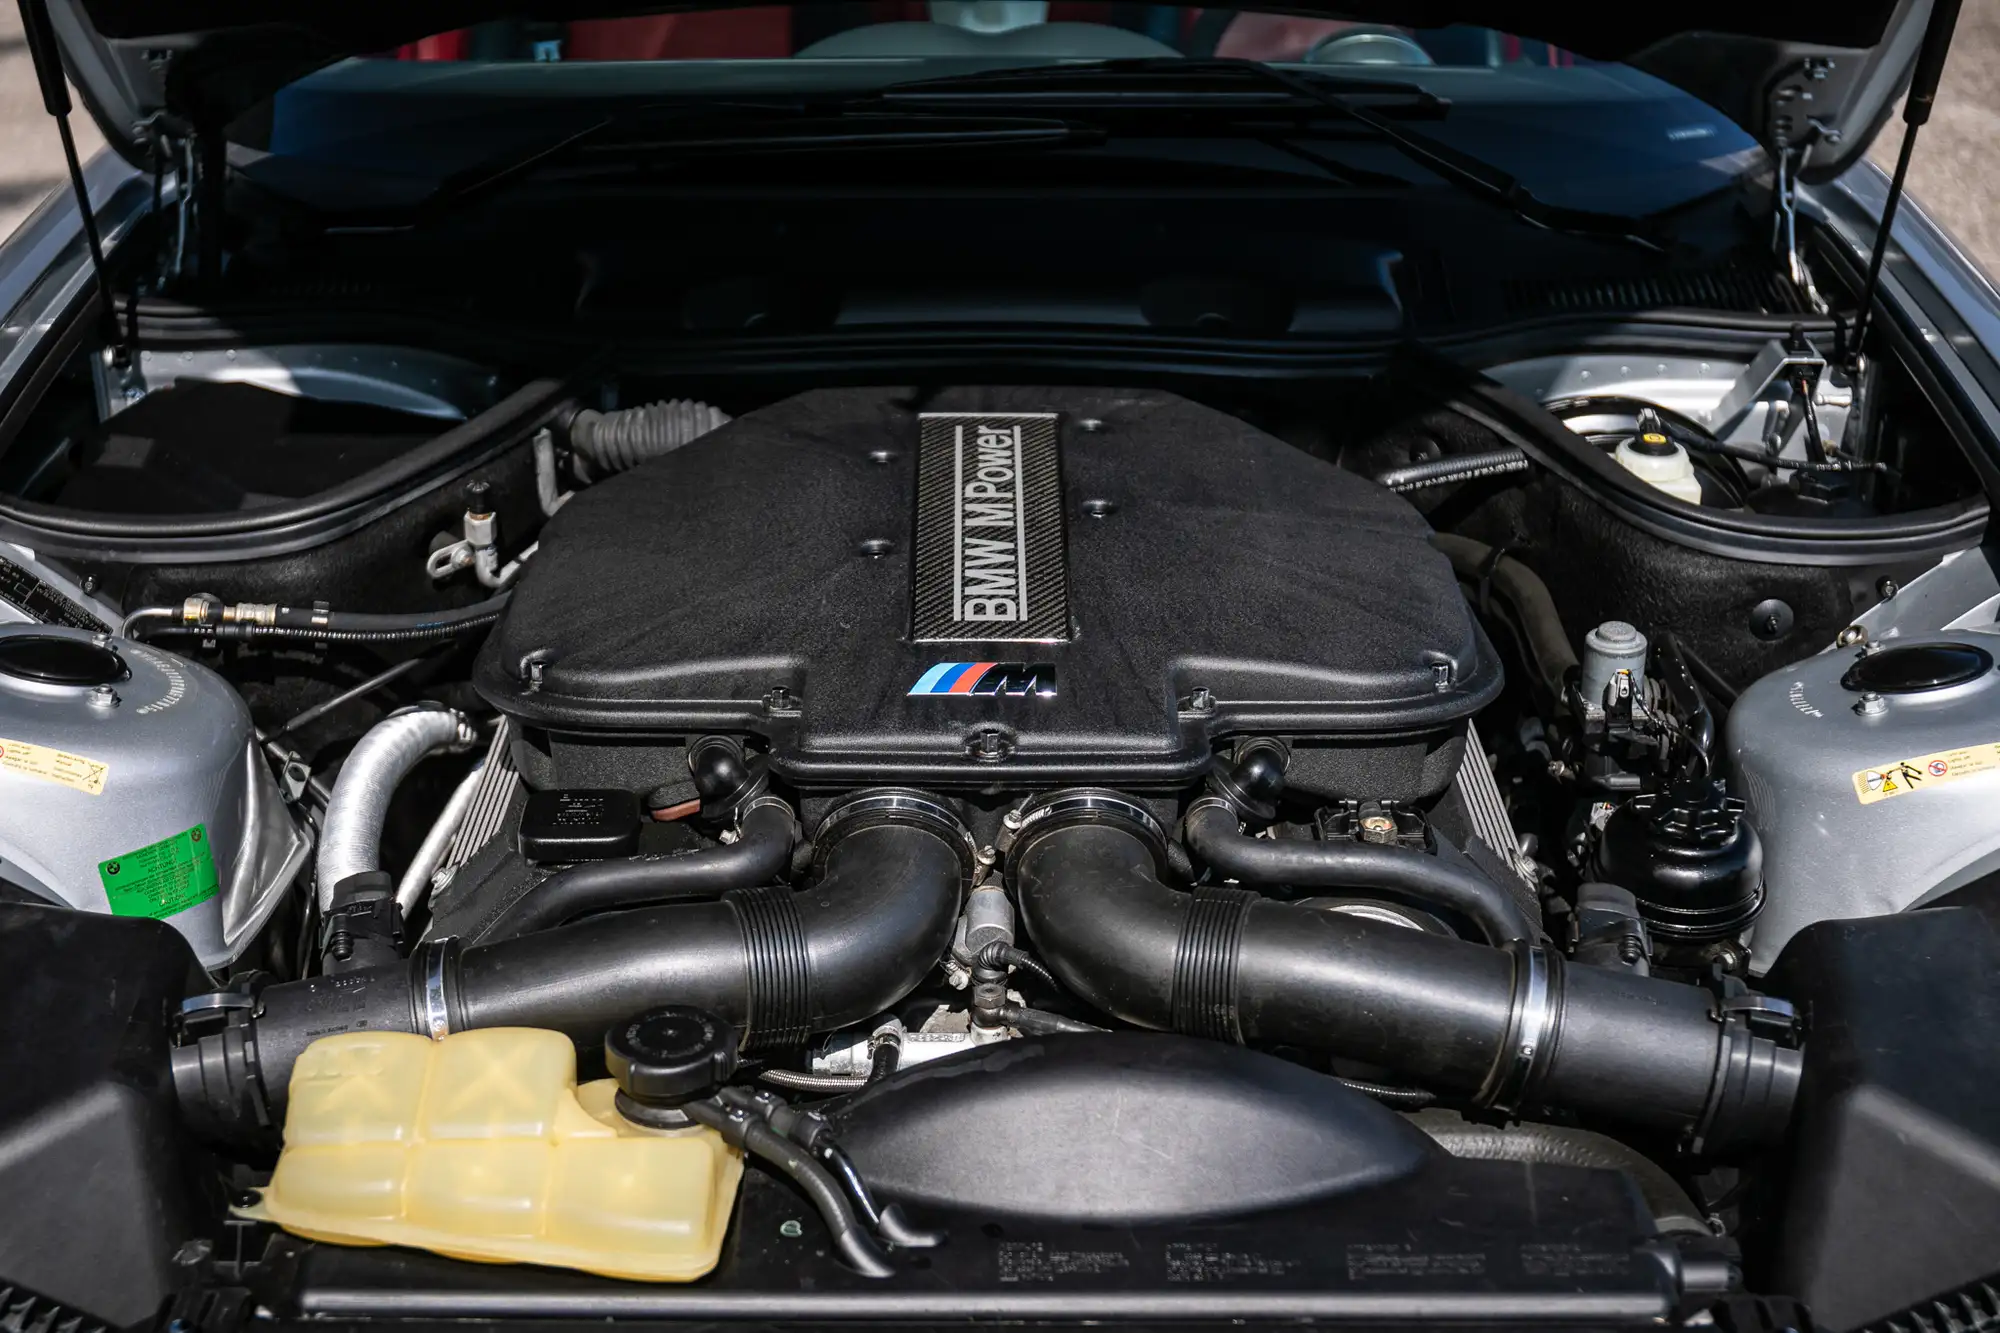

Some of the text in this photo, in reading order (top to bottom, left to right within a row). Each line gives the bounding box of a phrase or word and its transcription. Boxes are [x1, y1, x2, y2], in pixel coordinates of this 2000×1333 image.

[964, 425, 1017, 621] BMW MPower
[969, 661, 1058, 697] M
